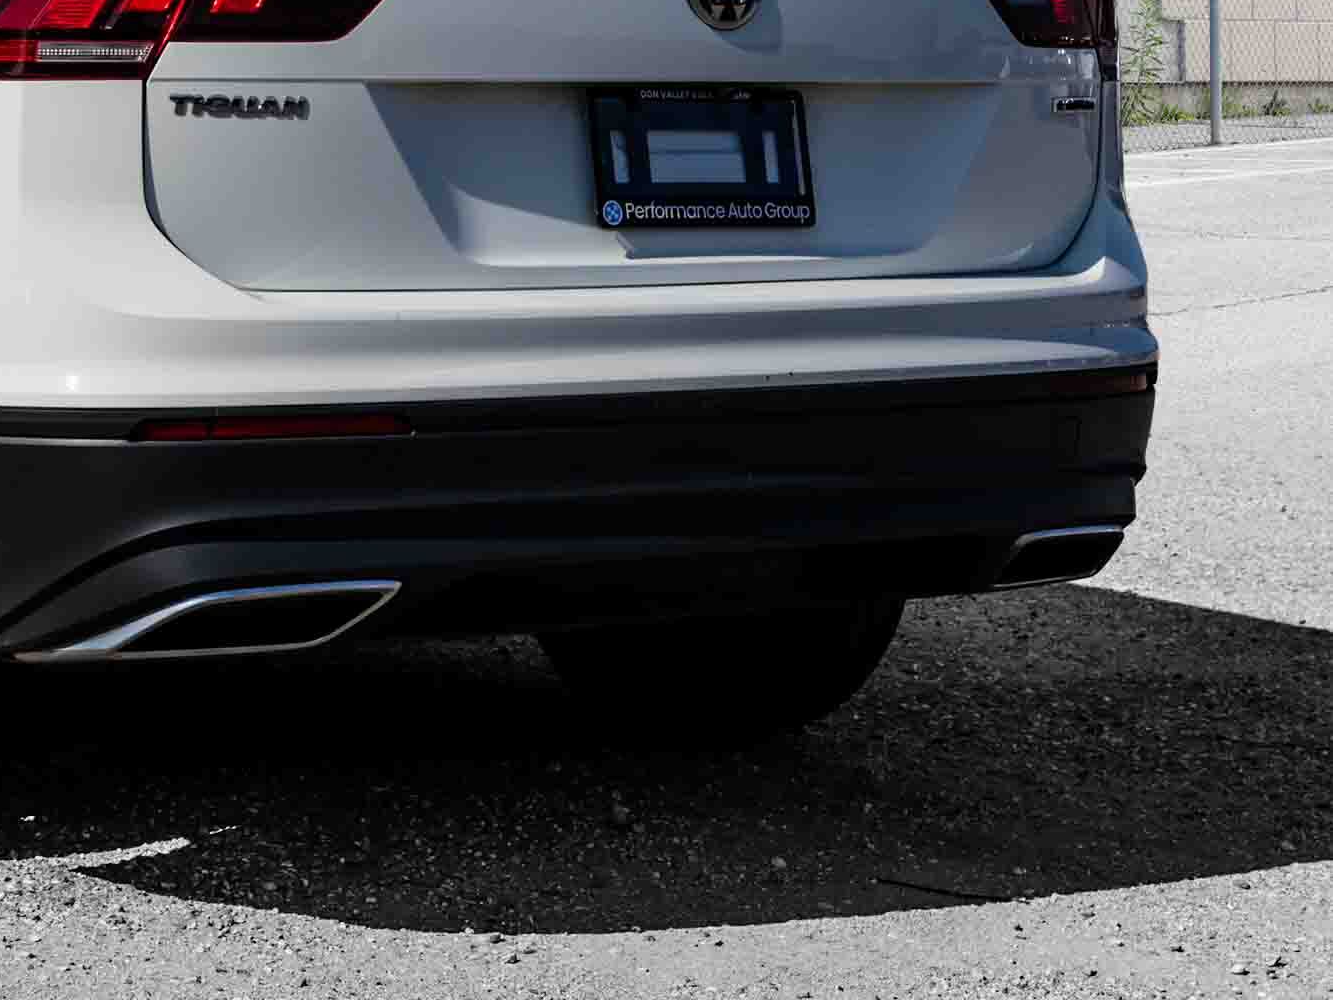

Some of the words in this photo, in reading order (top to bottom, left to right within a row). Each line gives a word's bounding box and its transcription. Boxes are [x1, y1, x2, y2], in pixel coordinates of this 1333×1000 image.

[170, 94, 311, 120] TIGUAN
[624, 202, 726, 220] Performance
[728, 202, 763, 220] Auto
[764, 202, 811, 224] Group
